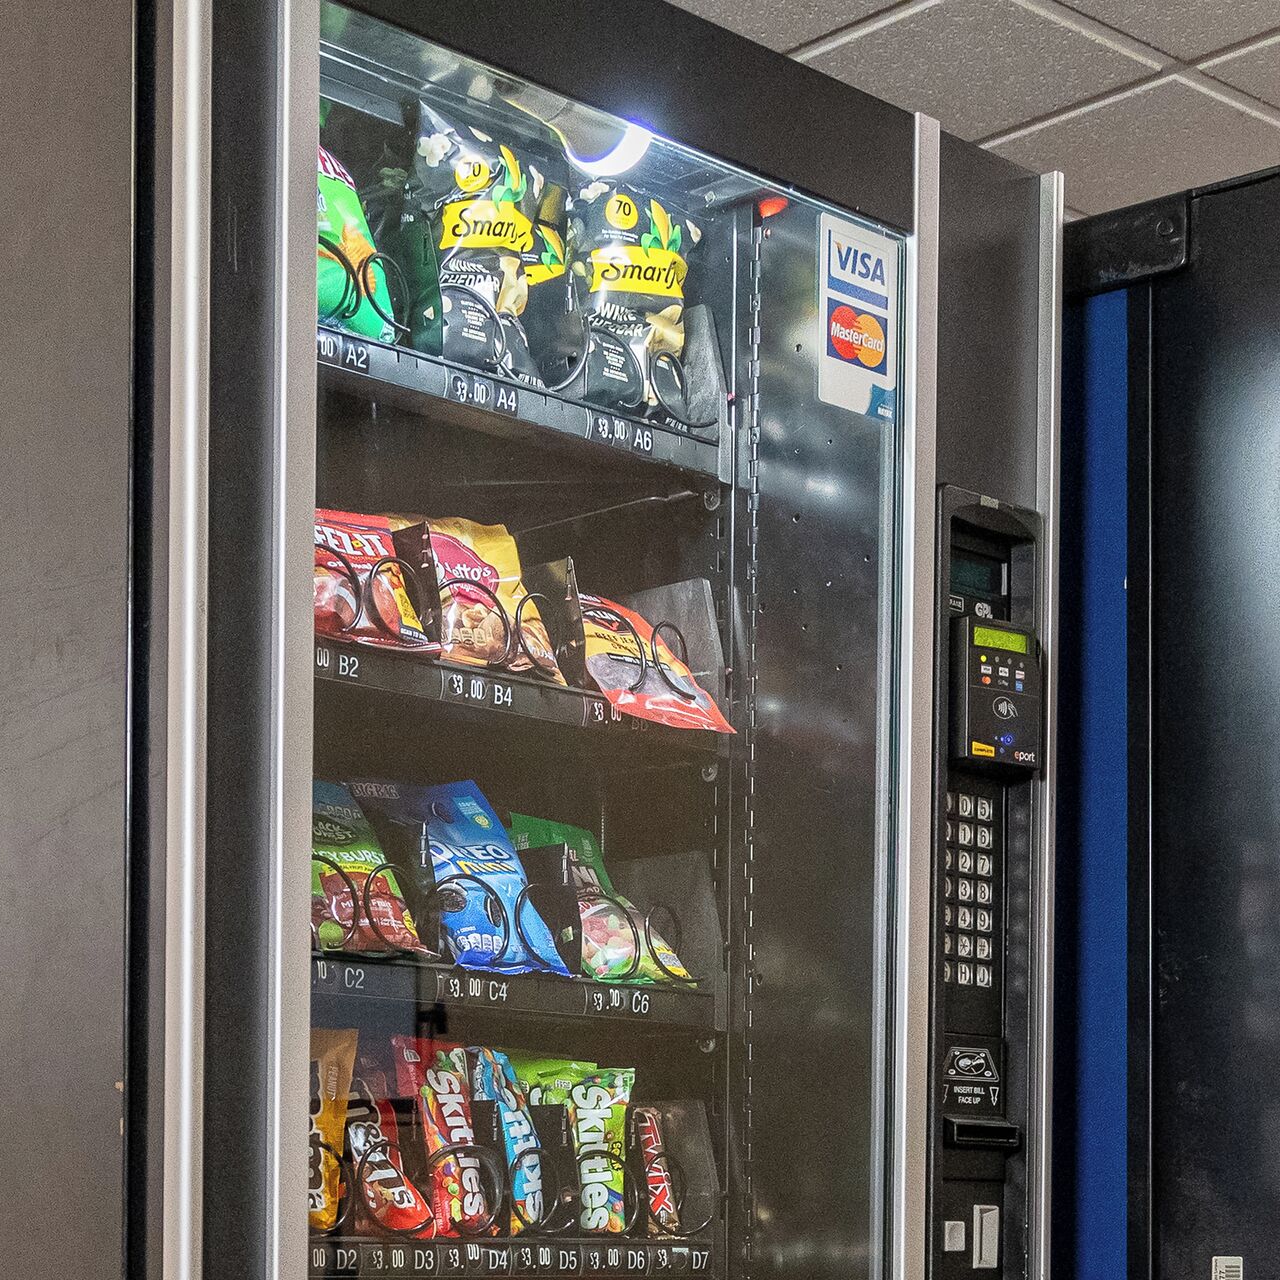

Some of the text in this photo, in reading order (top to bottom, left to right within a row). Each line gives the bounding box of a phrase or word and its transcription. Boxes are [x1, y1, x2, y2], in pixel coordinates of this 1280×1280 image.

[615, 200, 632, 216] 70
[833, 241, 886, 287] VISA
[830, 321, 885, 353] MasterCard
[346, 344, 368, 369] A2
[496, 387, 518, 412] A4
[633, 429, 653, 452] A6
[339, 654, 359, 678] B2
[494, 684, 513, 707] B4
[1014, 750, 1036, 763] eport
[961, 796, 968, 814] 0
[979, 800, 987, 817] 5
[962, 826, 967, 842] 1
[979, 829, 987, 846] 6
[429, 840, 510, 865] OREO
[960, 854, 967, 870] 2
[980, 856, 987, 872] 7
[960, 882, 967, 897] 3
[979, 884, 987, 900] 8
[960, 909, 967, 925] 4
[979, 912, 987, 929] 9
[344, 966, 365, 989] C2
[960, 965, 967, 980] H
[489, 980, 508, 1002] C4
[632, 992, 650, 1014] C6
[953, 1086, 974, 1094] INSERT
[958, 1096, 981, 1105] FACE UP
[336, 1248, 358, 1270] D2
[413, 1249, 435, 1270] D3
[488, 1251, 508, 1270] D4
[559, 1252, 577, 1270] D5
[627, 1252, 645, 1270] D6
[692, 1251, 709, 1270] D7
